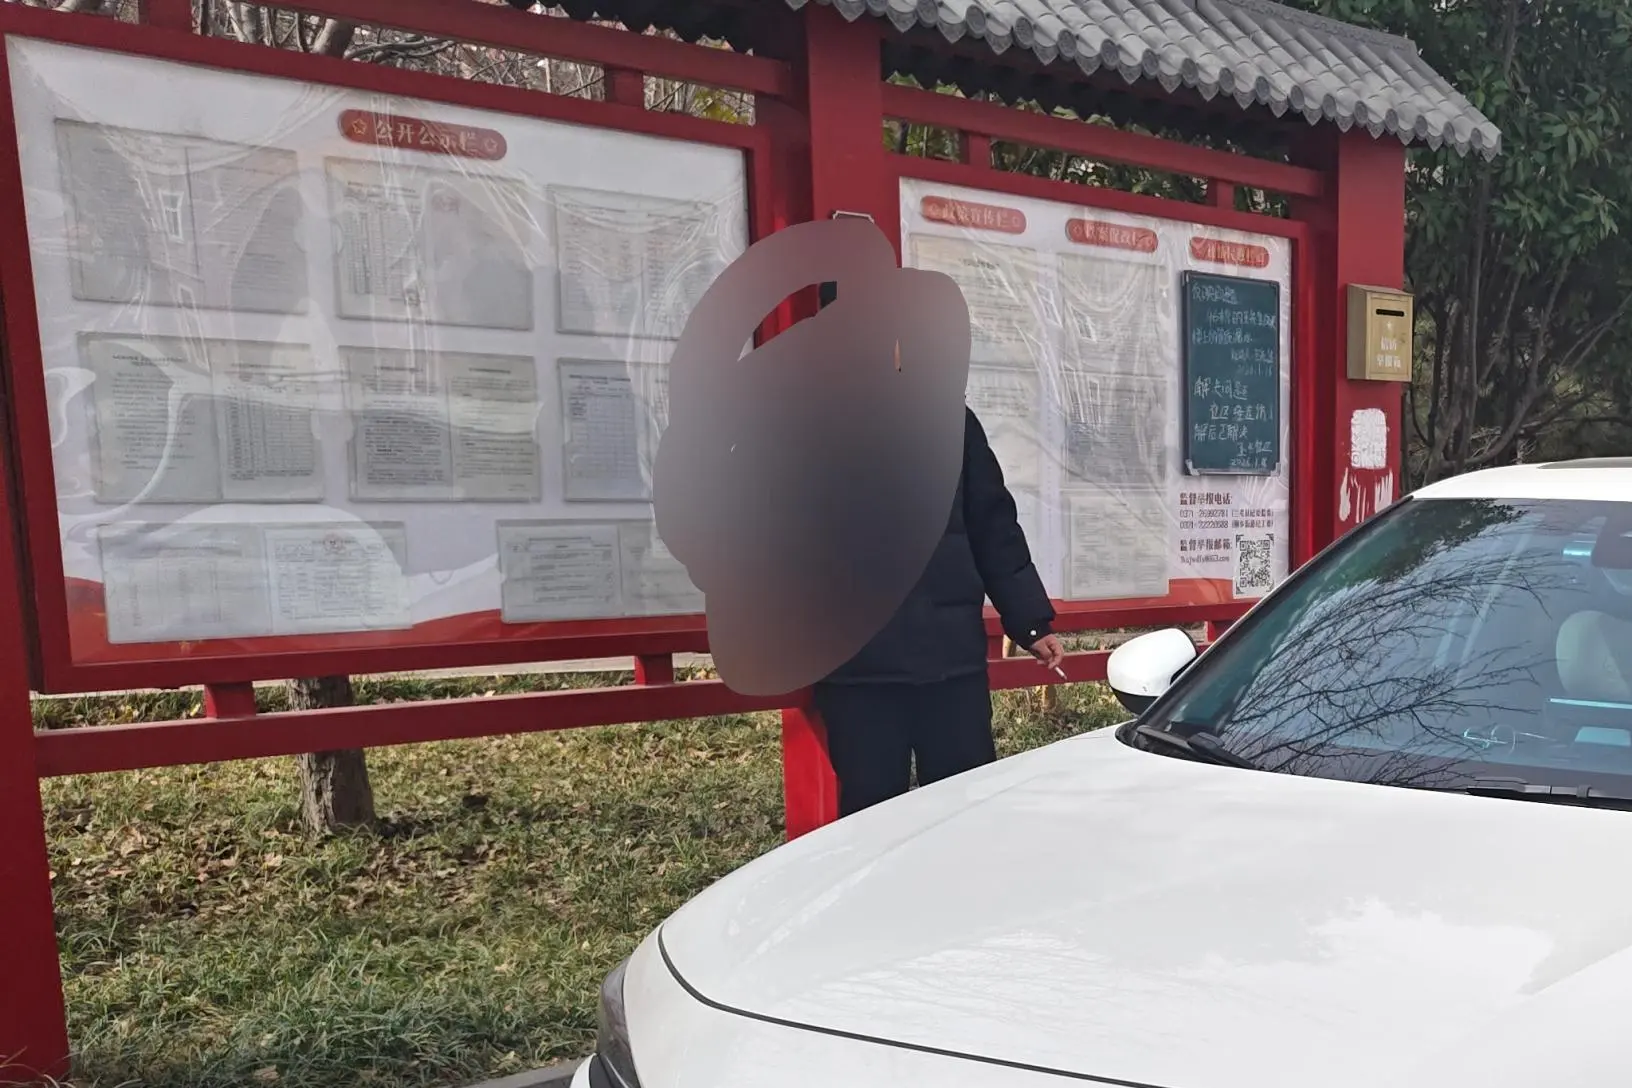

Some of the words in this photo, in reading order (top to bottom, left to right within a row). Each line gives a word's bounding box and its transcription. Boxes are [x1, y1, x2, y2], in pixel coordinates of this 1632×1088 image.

[376, 119, 477, 151] 公开公示栏
